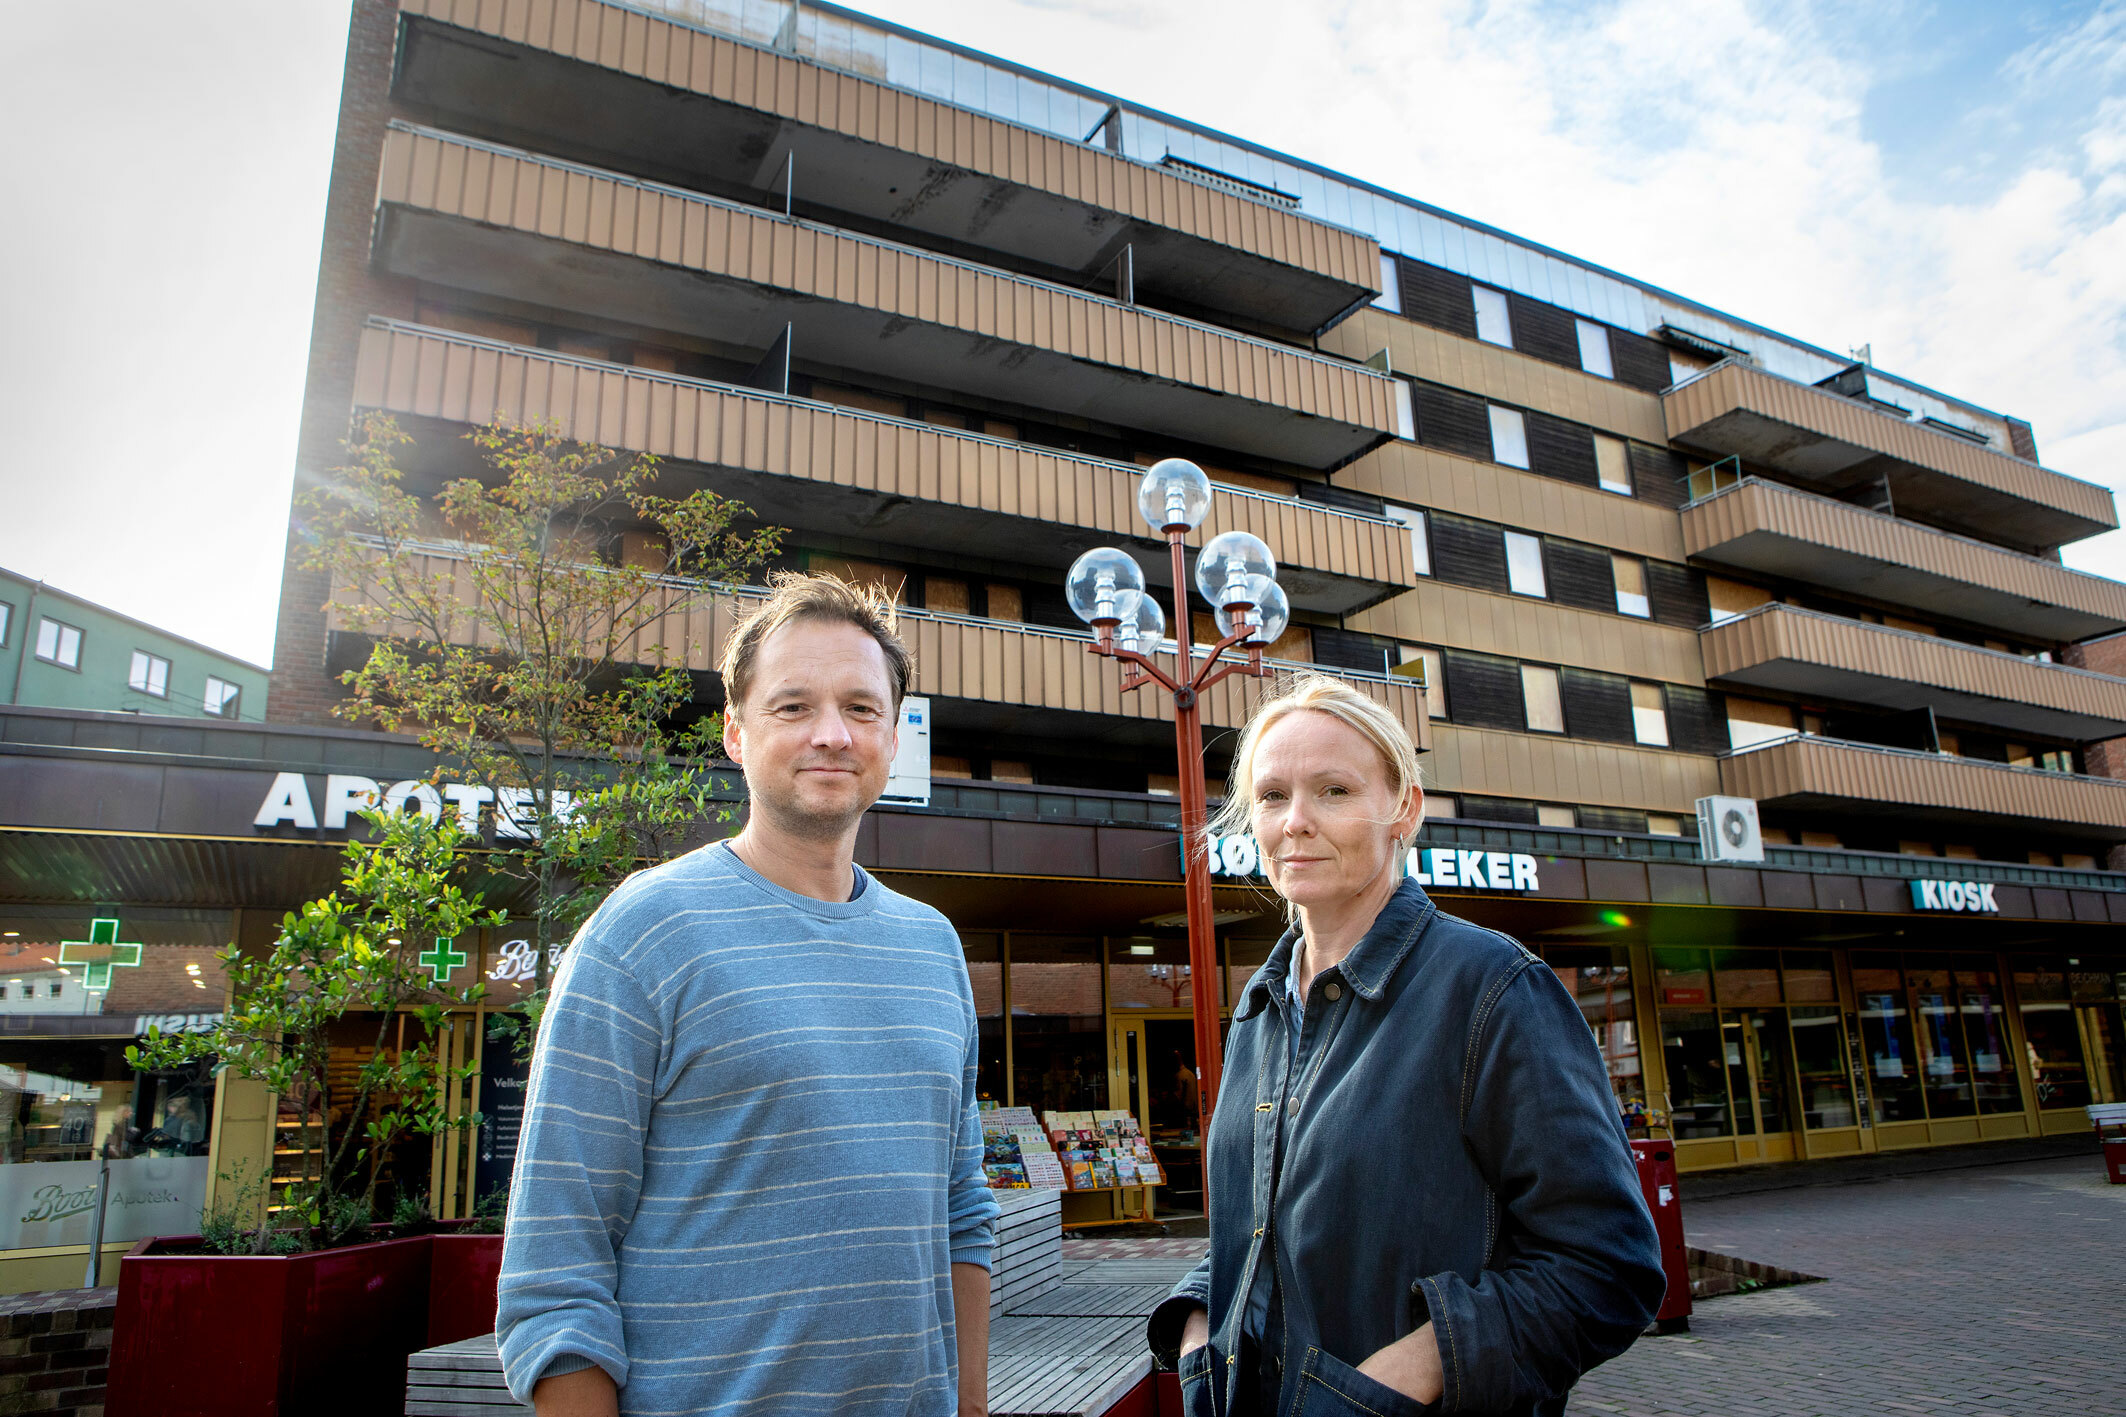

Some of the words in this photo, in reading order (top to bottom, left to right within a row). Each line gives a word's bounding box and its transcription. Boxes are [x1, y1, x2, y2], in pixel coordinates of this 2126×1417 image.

[1406, 847, 1539, 891] LEKER
[1920, 879, 1999, 912] KIOSK
[493, 1077, 521, 1088] Velko
[21, 1184, 97, 1222] Boot
[111, 1189, 174, 1208] Apotek
